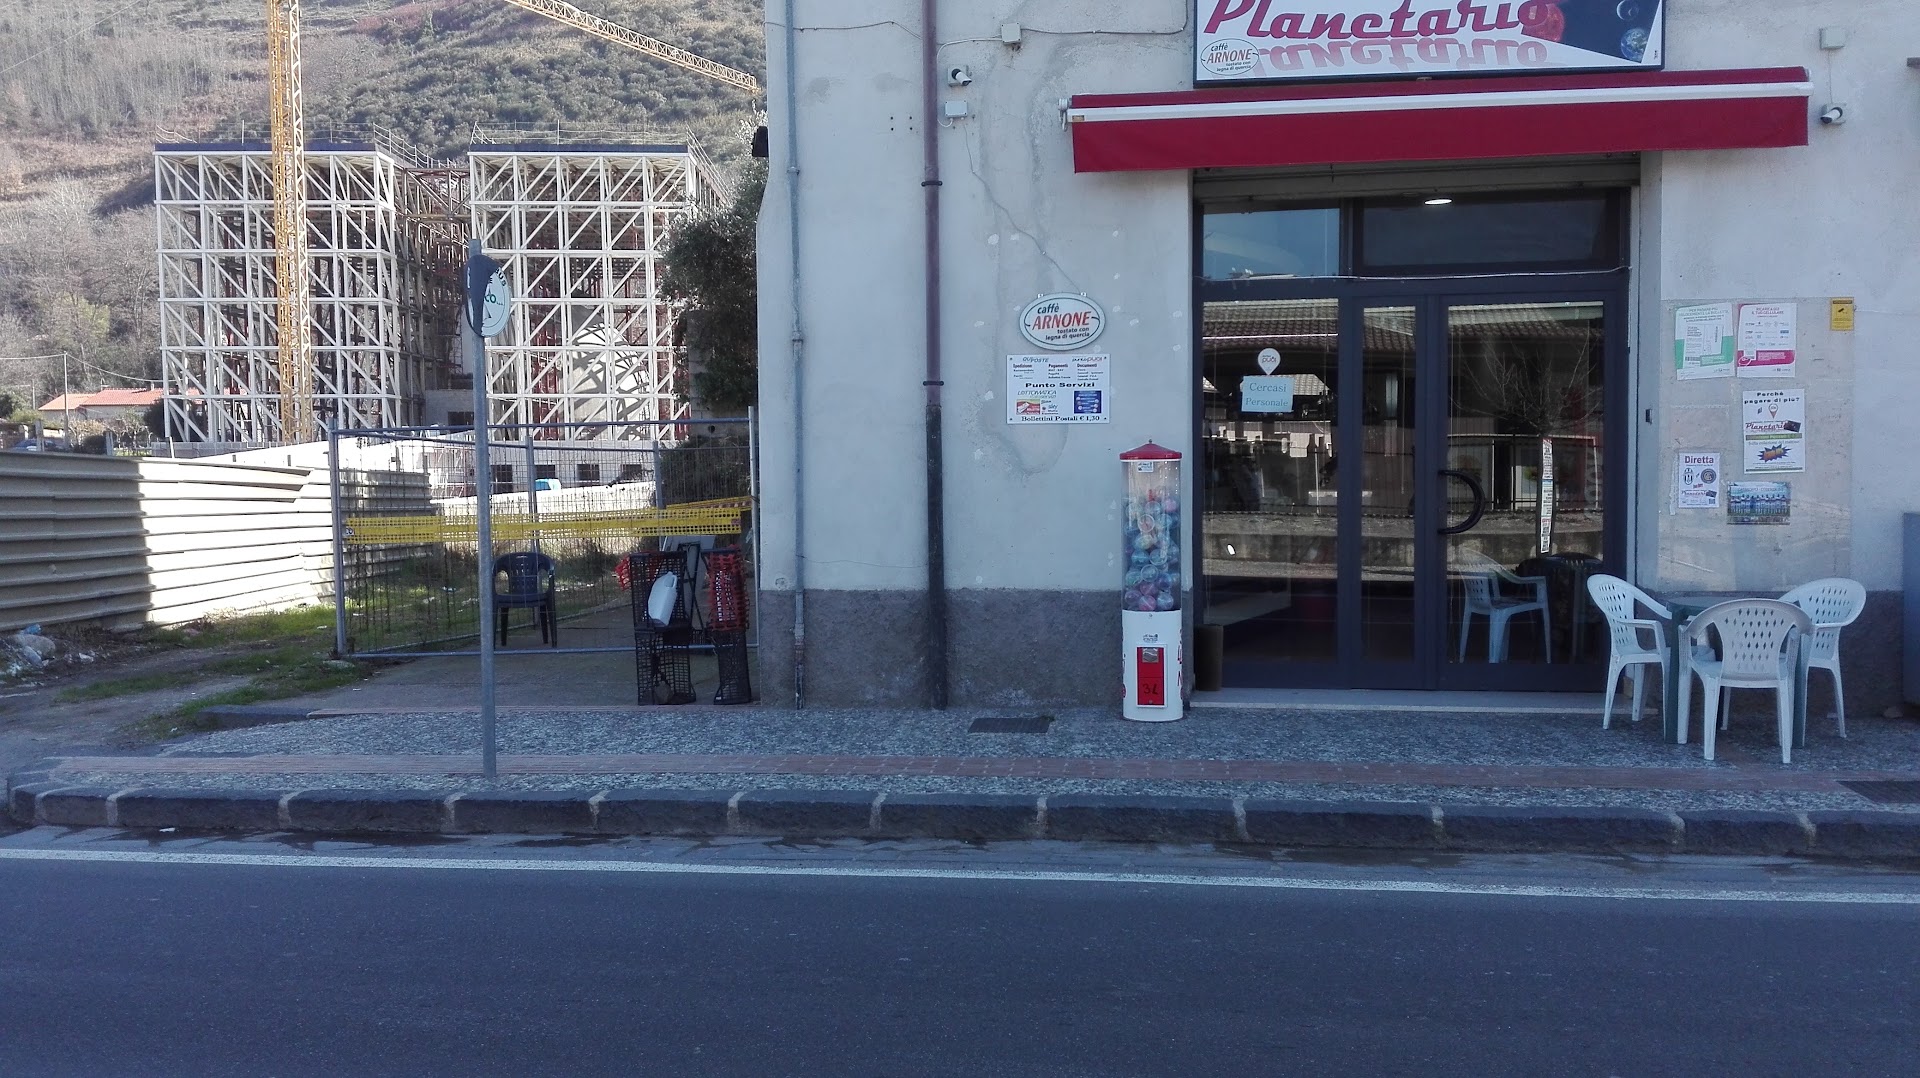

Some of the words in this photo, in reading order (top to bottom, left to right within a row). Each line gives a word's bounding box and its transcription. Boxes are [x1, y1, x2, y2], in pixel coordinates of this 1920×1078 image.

[1203, 0, 1550, 40] Planetario
[1210, 42, 1229, 52] caffè
[1206, 48, 1253, 65] ARNONE
[1037, 303, 1060, 314] caffè
[1031, 311, 1092, 331] ARNONE
[1069, 332, 1090, 340] quercia
[1249, 382, 1287, 393] Cercasi
[1245, 397, 1289, 407] Personale
[1684, 455, 1714, 464] Diretta
